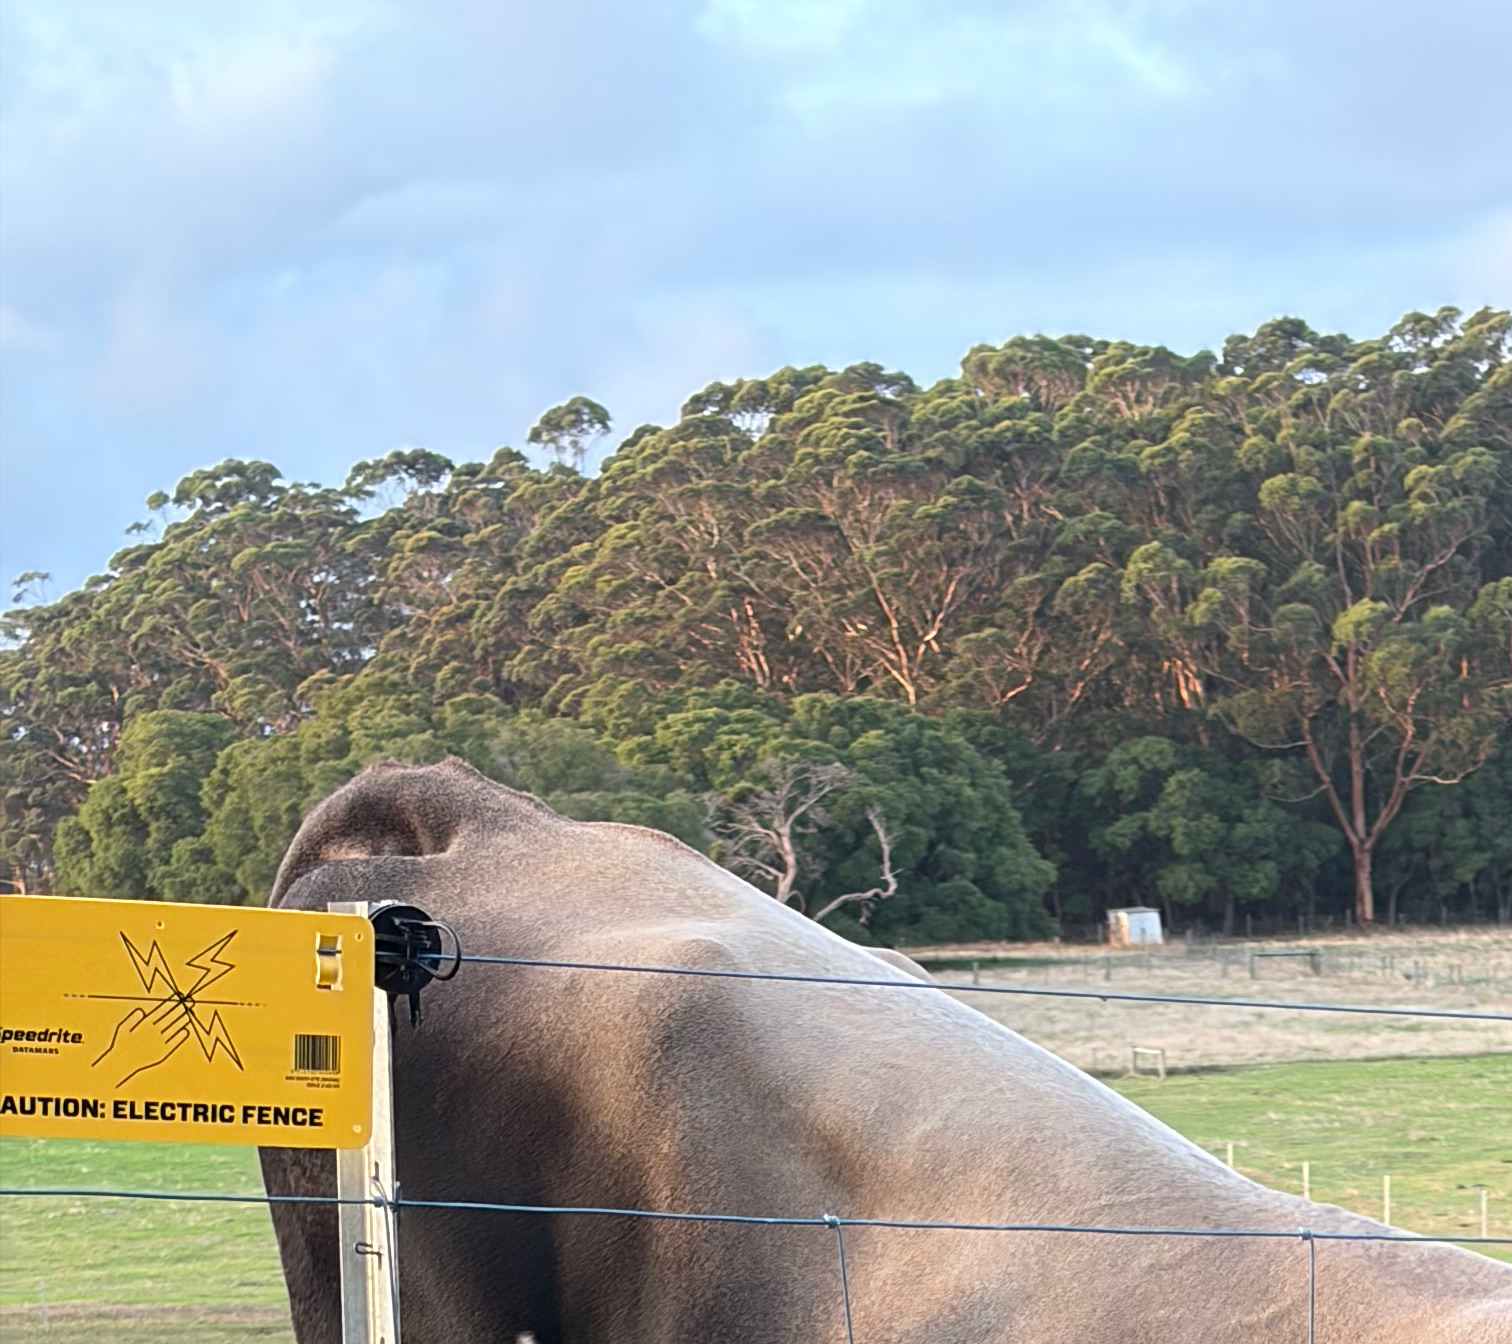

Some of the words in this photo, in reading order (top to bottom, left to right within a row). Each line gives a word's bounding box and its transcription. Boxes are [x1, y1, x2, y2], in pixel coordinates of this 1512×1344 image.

[0, 1027, 84, 1044] peedrite
[12, 1046, 59, 1054] DATAMARS
[0, 1095, 105, 1118] AUTION:
[112, 1100, 235, 1124] ELECTRIC
[241, 1105, 324, 1127] FENCE
